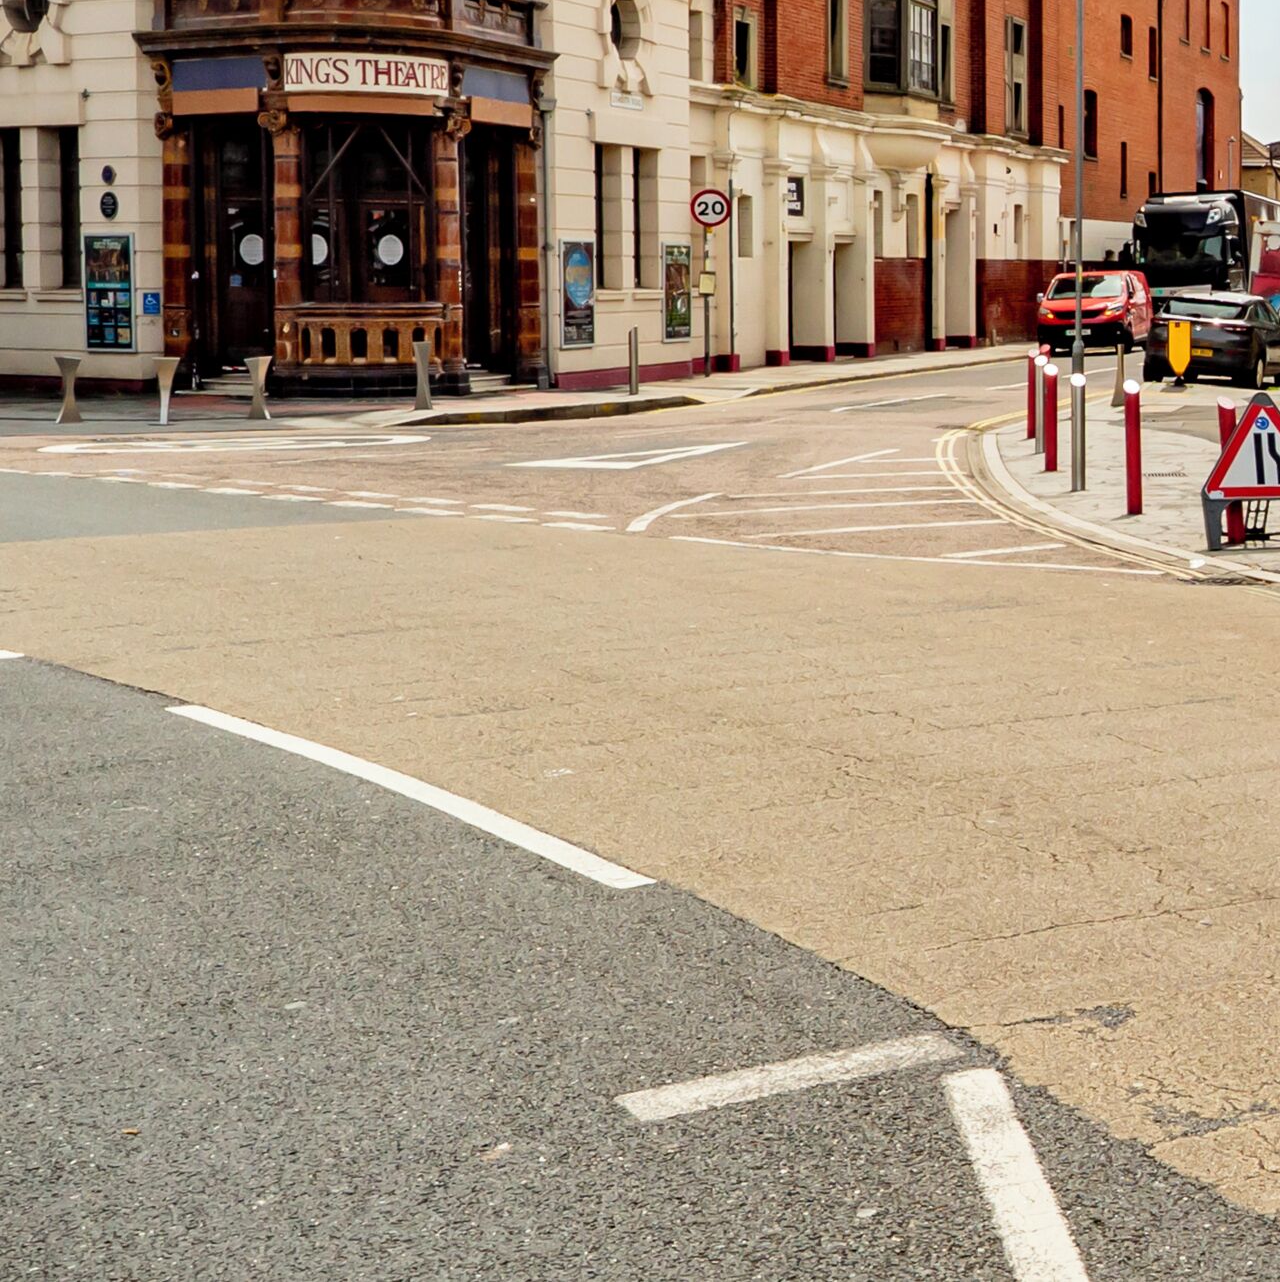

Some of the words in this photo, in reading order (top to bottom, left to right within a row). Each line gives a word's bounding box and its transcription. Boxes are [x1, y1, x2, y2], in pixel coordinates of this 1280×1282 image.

[285, 56, 349, 85] KING'S
[354, 58, 448, 91] THEATRE
[697, 200, 725, 216] 20
